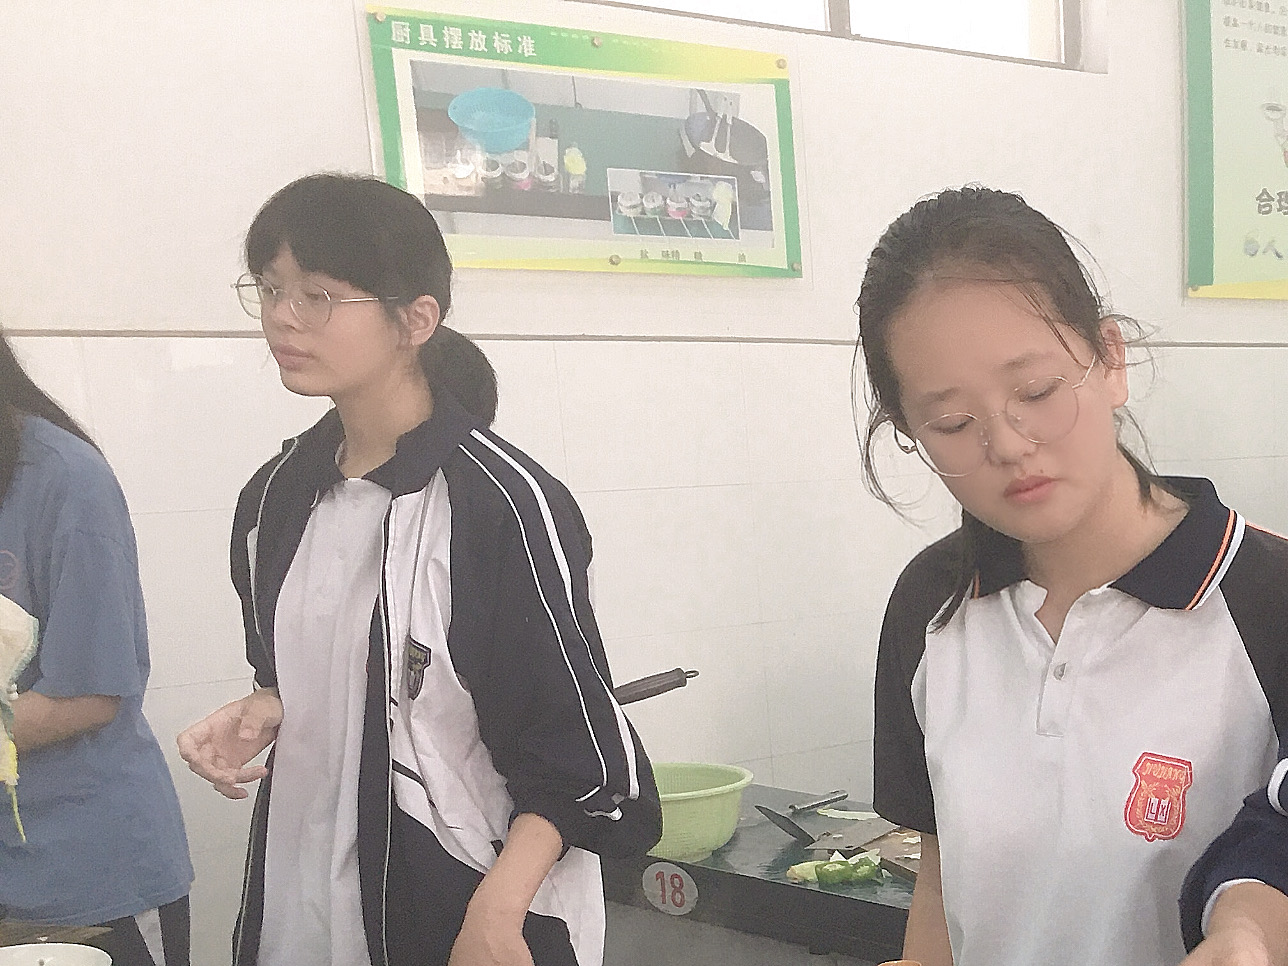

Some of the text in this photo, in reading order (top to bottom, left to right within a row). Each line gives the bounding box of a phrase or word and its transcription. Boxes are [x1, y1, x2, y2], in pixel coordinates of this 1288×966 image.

[391, 20, 537, 57] 厨具摆放标准
[655, 871, 685, 908] 18
